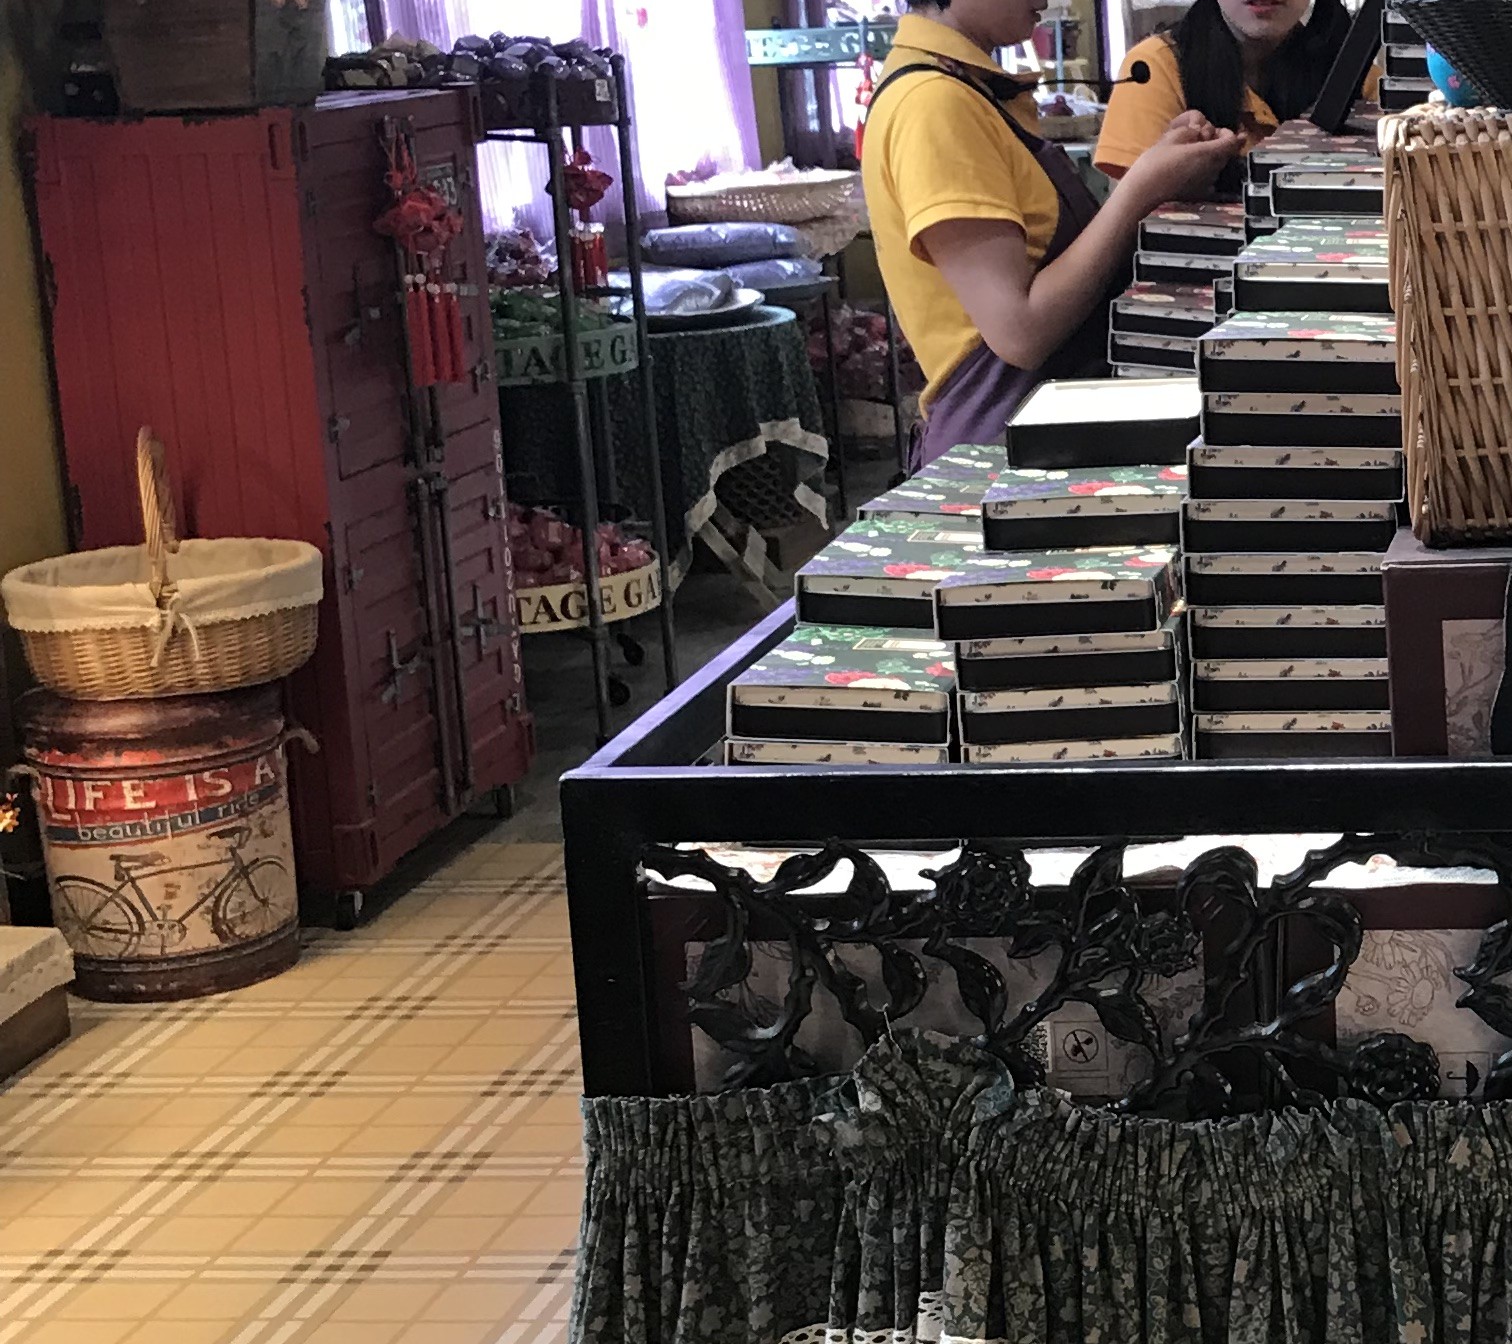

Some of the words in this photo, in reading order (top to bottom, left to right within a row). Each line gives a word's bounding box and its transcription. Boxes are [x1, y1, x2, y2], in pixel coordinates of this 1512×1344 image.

[46, 777, 157, 820] LIFE
[185, 768, 232, 802] IS
[255, 755, 276, 785] A
[75, 802, 201, 841] beautiful
